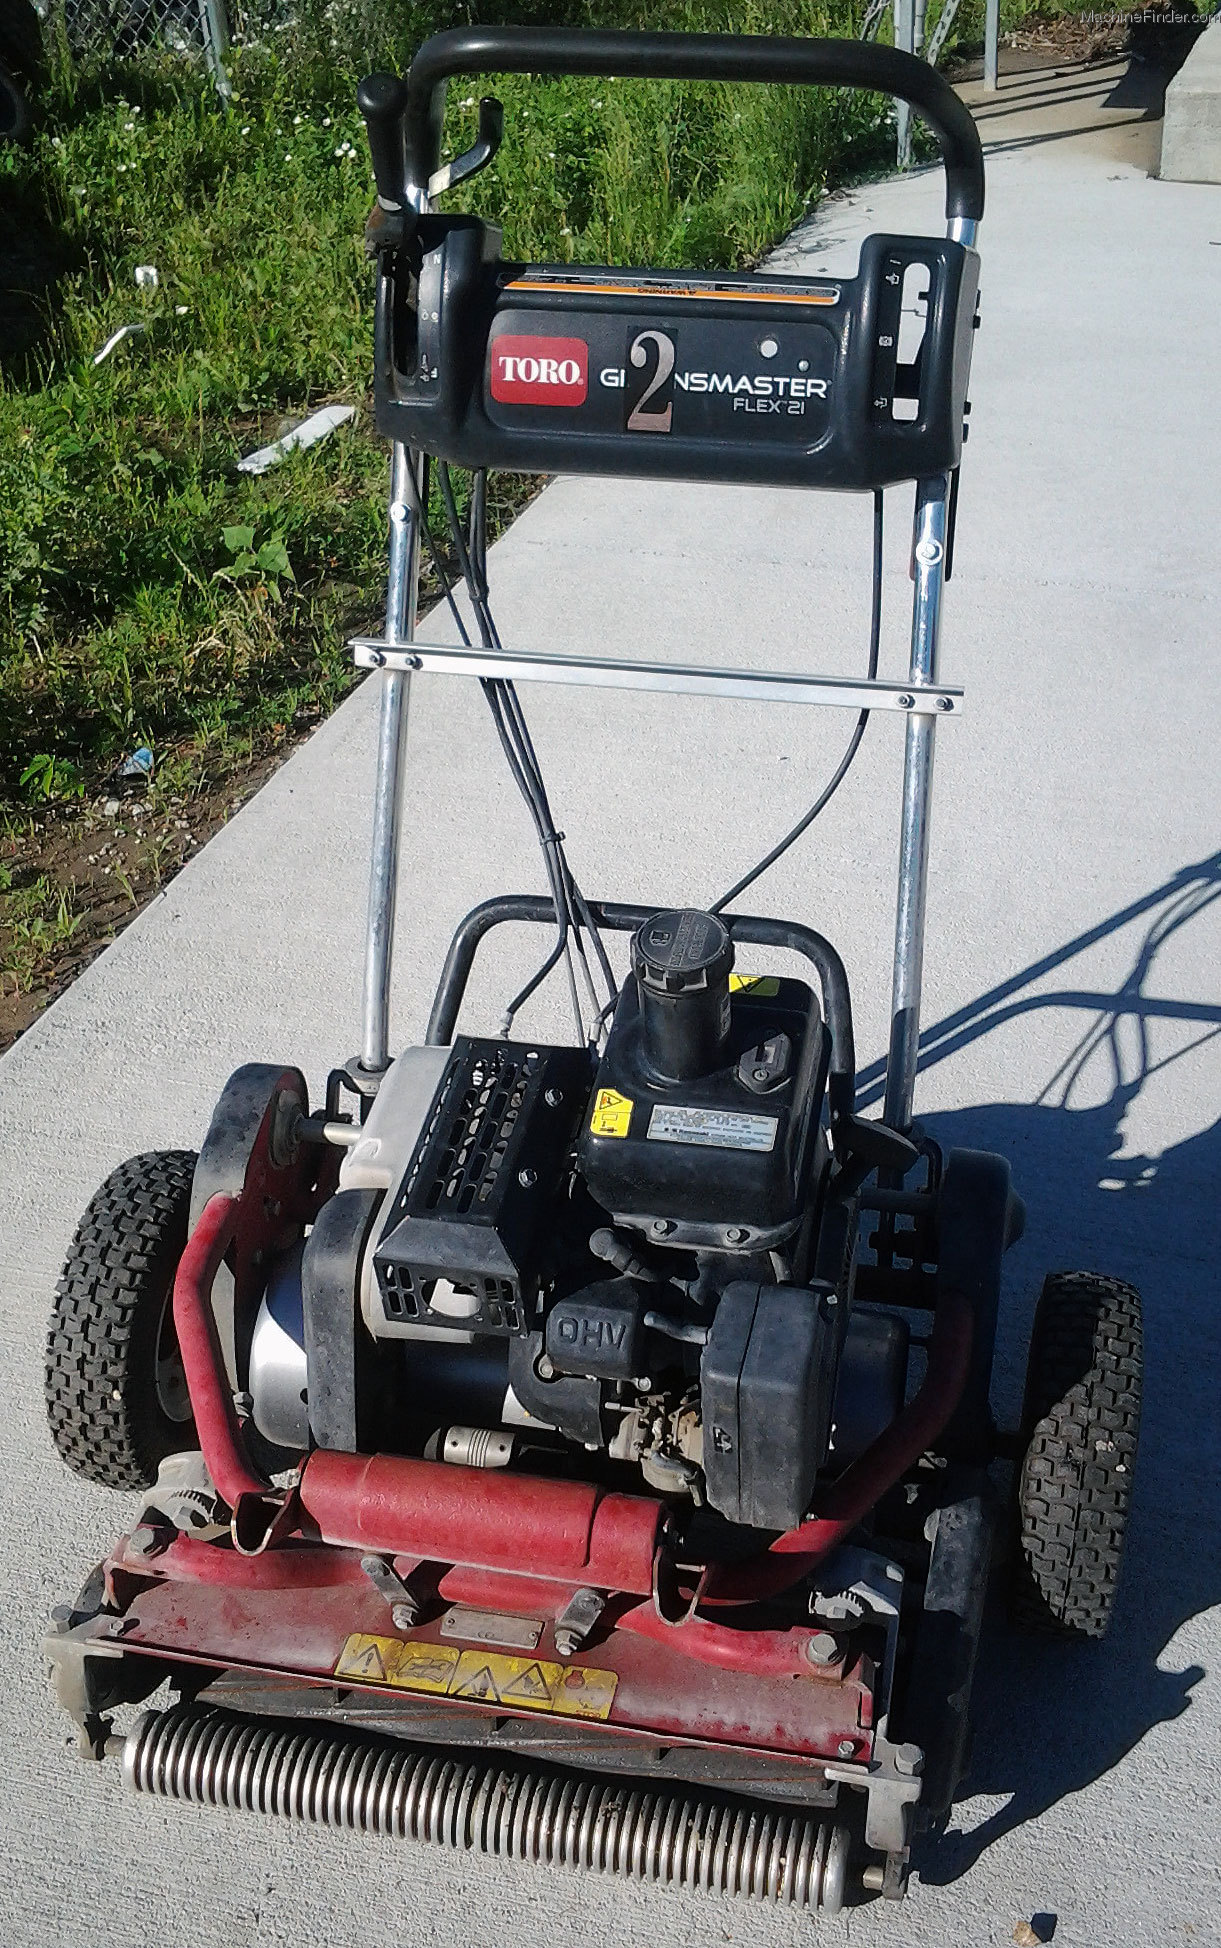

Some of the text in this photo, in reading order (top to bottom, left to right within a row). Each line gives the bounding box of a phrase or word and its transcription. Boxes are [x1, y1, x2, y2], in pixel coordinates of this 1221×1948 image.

[499, 356, 581, 385] TORO
[627, 330, 675, 432] 2
[733, 397, 781, 413] FLEX
[557, 1316, 627, 1349] OHV
